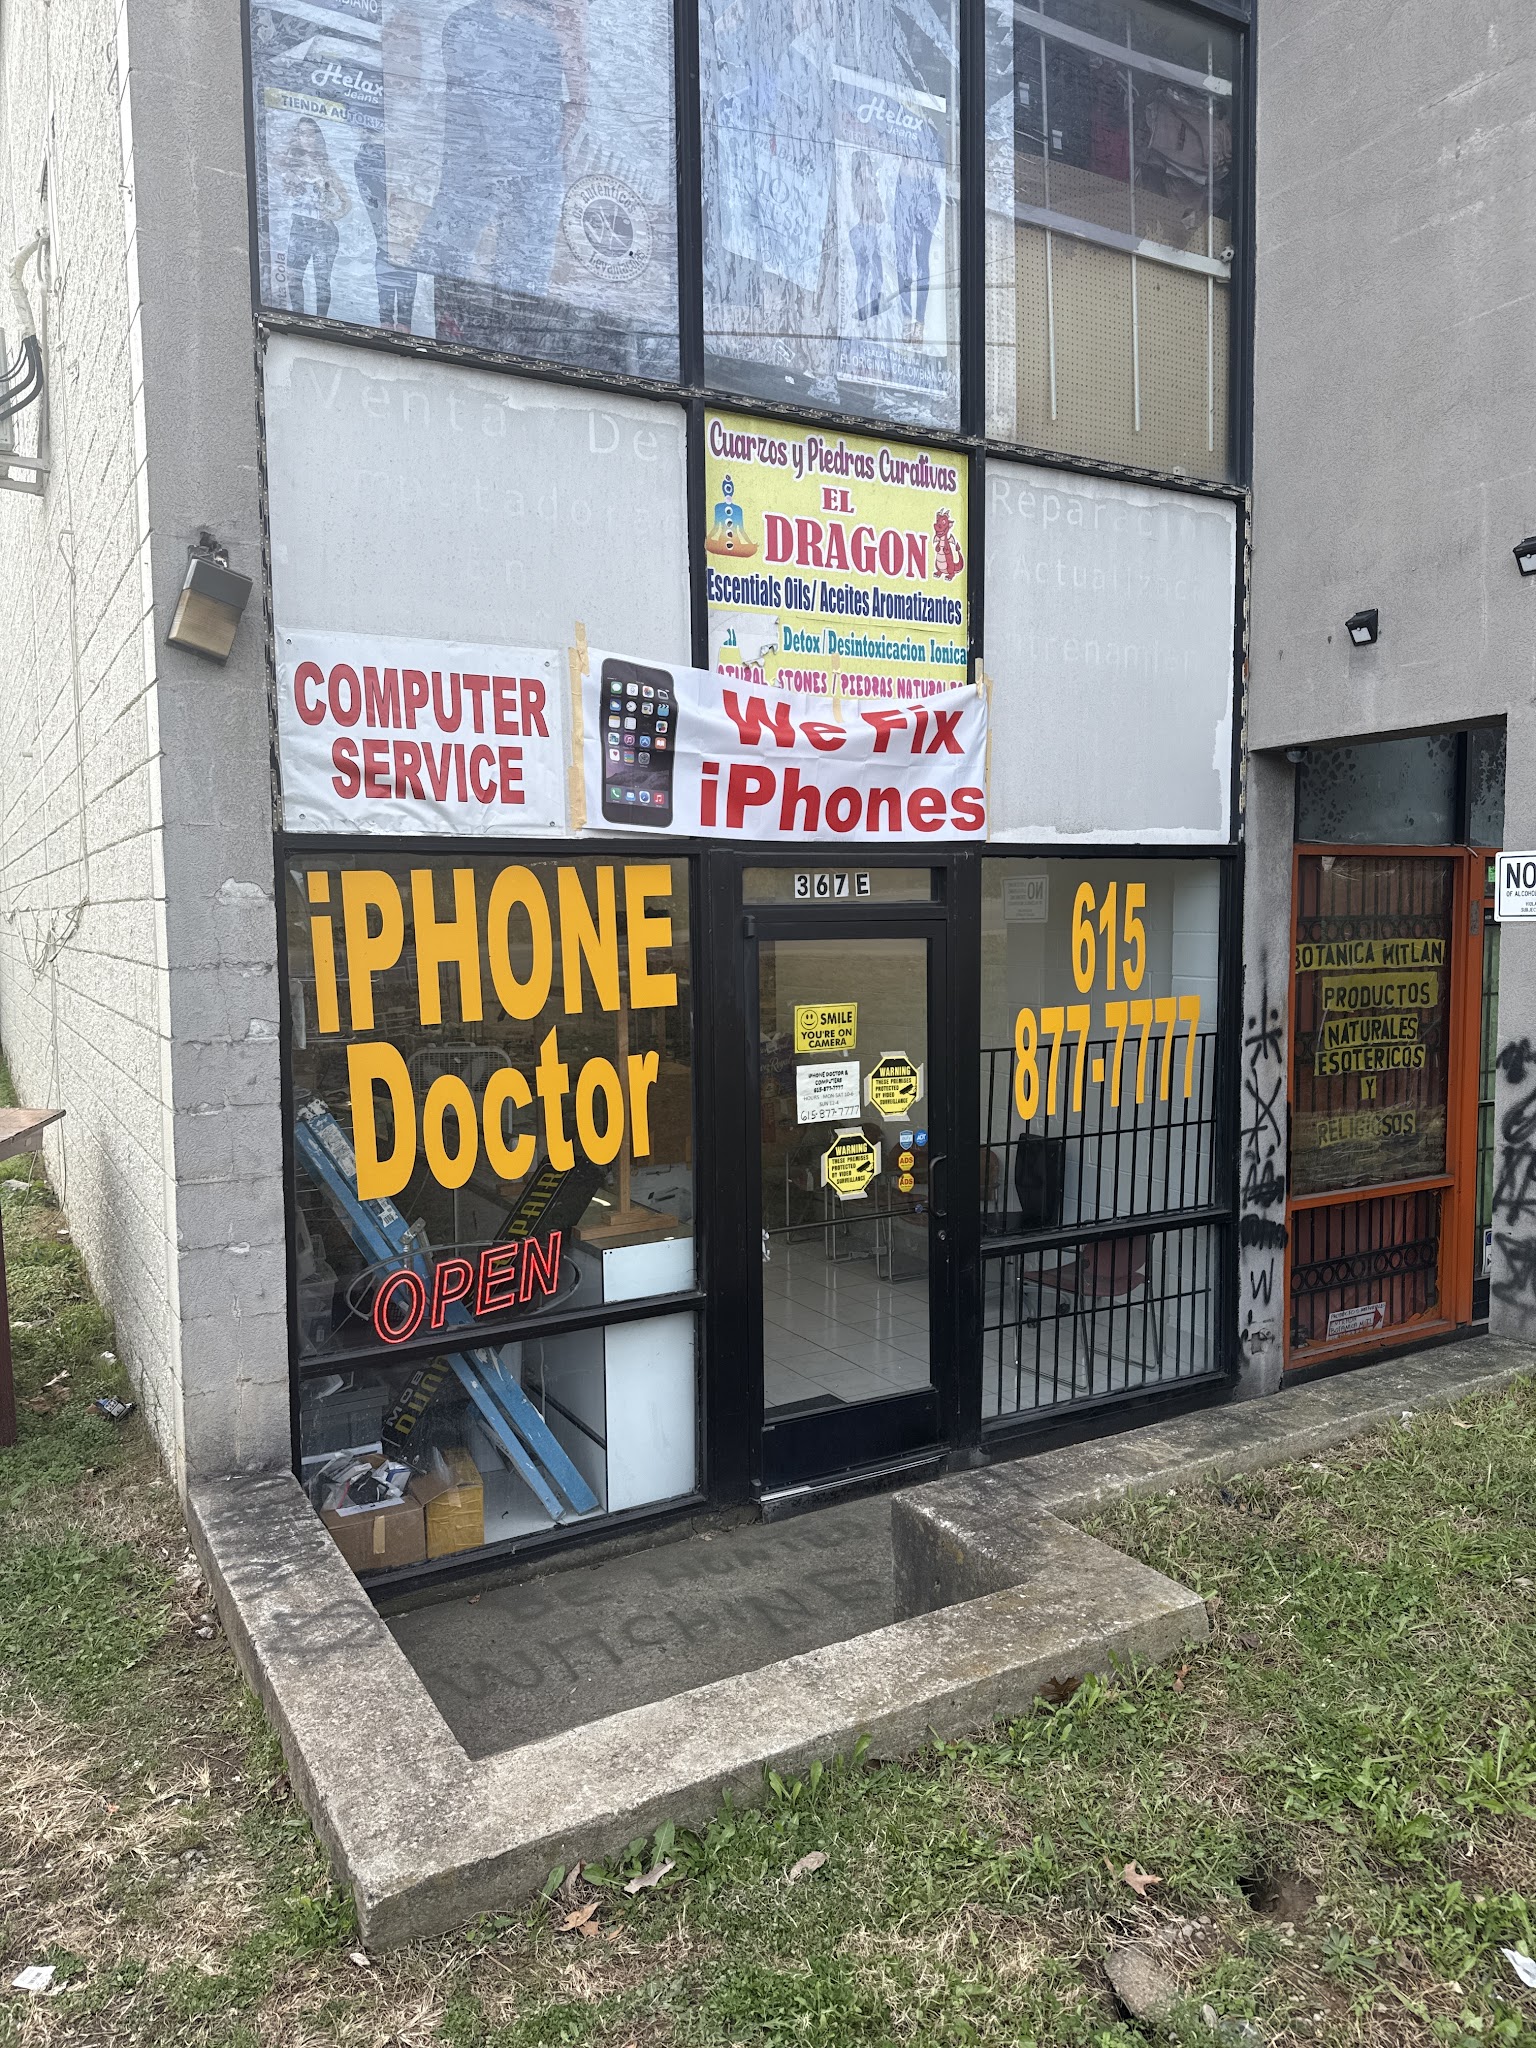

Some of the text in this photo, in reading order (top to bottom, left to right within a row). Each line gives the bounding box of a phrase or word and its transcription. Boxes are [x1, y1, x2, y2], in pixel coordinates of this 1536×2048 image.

[311, 62, 385, 97] Helax
[344, 89, 379, 104] Jeans
[282, 95, 386, 130] TIENDA AUTORIZ
[857, 96, 923, 132] Helax
[886, 125, 918, 140] Jeans
[275, 252, 286, 282] Cola
[308, 366, 658, 462] Venta De
[710, 420, 957, 492] Cuarzos y Piedras Curativas
[822, 487, 854, 514] EL
[765, 514, 928, 579] DRAGON
[707, 568, 781, 608] Escentials
[820, 581, 869, 617] Aceites
[872, 587, 962, 626] Aromatizantes
[930, 639, 967, 665] Ionica
[778, 669, 828, 694] STONES
[841, 674, 893, 699] PIEDRAS
[297, 661, 549, 738] COMPUTER
[722, 690, 967, 755] We Fix
[330, 737, 526, 805] SERVICE
[700, 762, 986, 833] iPhones
[1506, 862, 1536, 889] NO
[307, 864, 678, 1033] iPHONE
[1071, 881, 1146, 993] 615
[1296, 941, 1375, 969] BOTANICA
[1324, 982, 1431, 1009] PRODUCTOS
[820, 1011, 853, 1025] SMILE
[1328, 1017, 1418, 1048] NATURALES
[801, 1028, 852, 1040] YOU'RE ON
[808, 1037, 847, 1048] CAMERA
[879, 1065, 911, 1077] WARNING
[1014, 995, 1201, 1120] 877-7777
[1318, 1046, 1424, 1076] ESOTERICOS
[891, 1077, 912, 1085] PREMISES
[1365, 1078, 1375, 1099] Y
[346, 1024, 661, 1201] Doctor
[835, 1142, 868, 1156] WARNING
[916, 1133, 927, 1141] ADT
[832, 1163, 856, 1171] PROTECTED
[899, 1156, 914, 1165] ADS
[836, 1175, 866, 1185] SURVEILLANCE
[899, 1178, 914, 1186] ADS
[373, 1231, 563, 1345] OPEN
